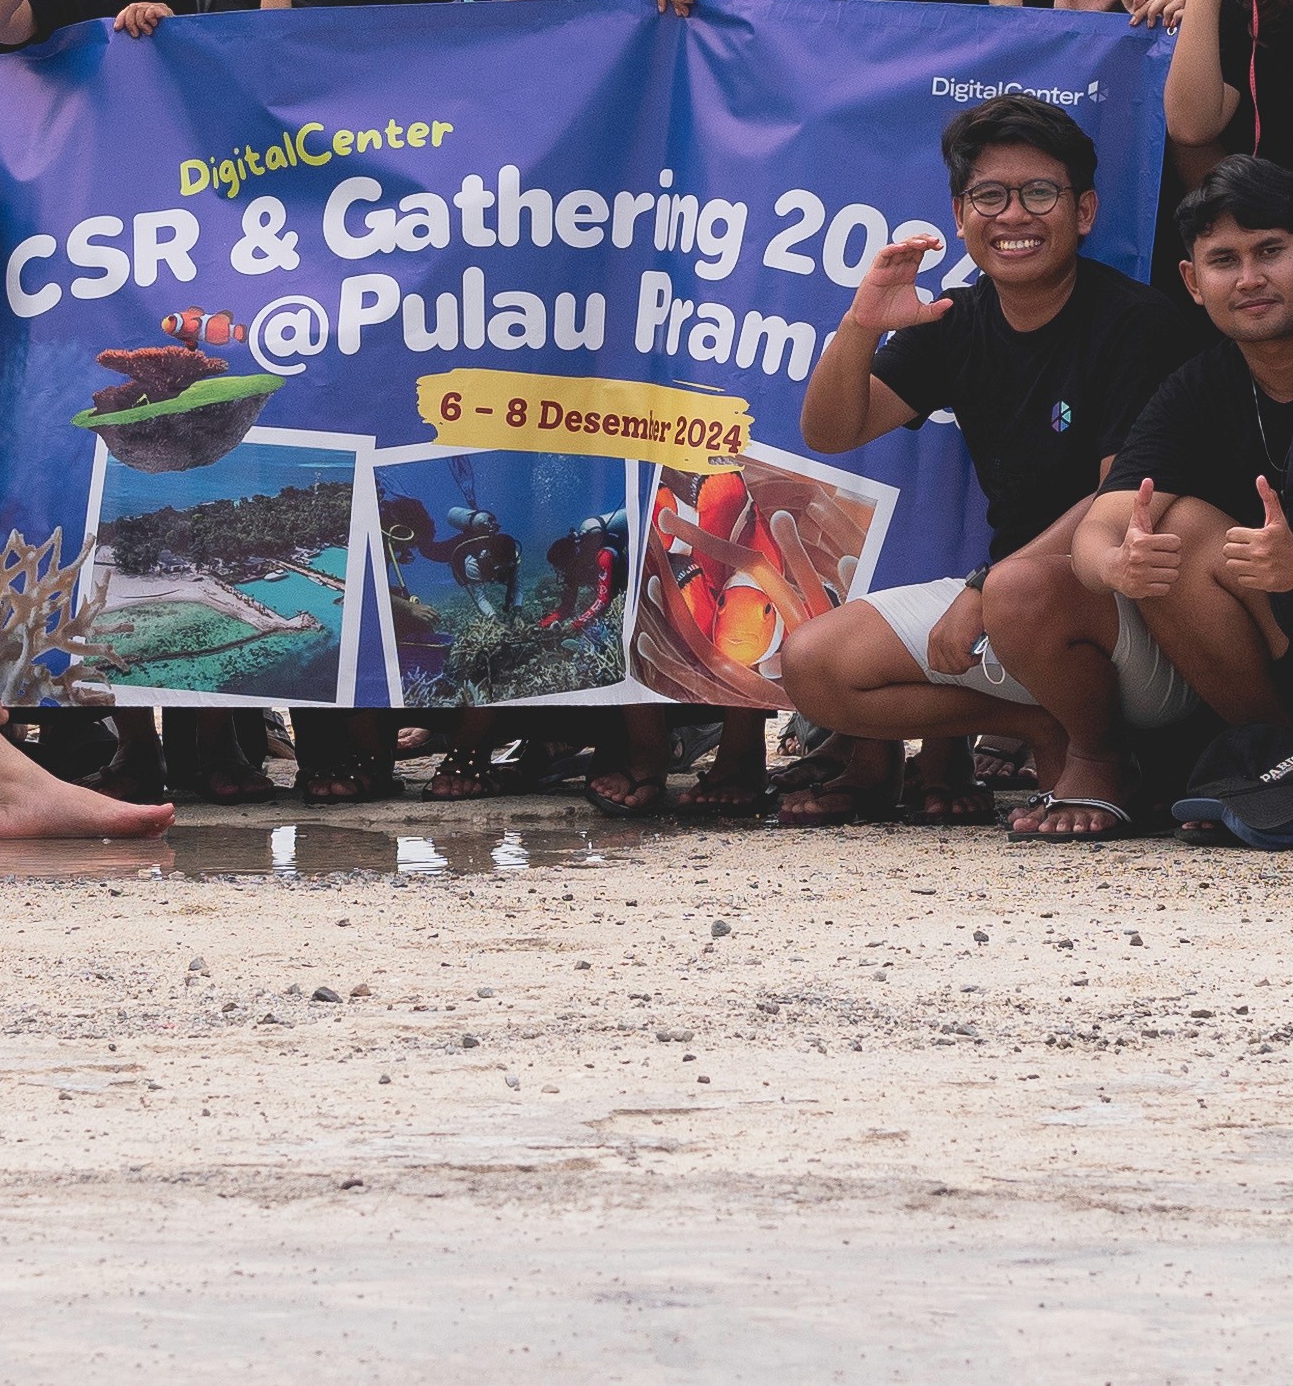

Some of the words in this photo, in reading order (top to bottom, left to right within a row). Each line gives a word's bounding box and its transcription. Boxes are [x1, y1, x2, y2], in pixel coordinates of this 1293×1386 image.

[180, 119, 454, 199] DigitalCenter
[6, 209, 201, 318] CSR
[230, 195, 301, 275] &
[323, 165, 748, 281] Gathering
[248, 266, 606, 376] @Pulau
[635, 270, 839, 382] Pram
[440, 392, 463, 422] 6
[506, 398, 528, 428] 8
[674, 416, 742, 454] 2024
